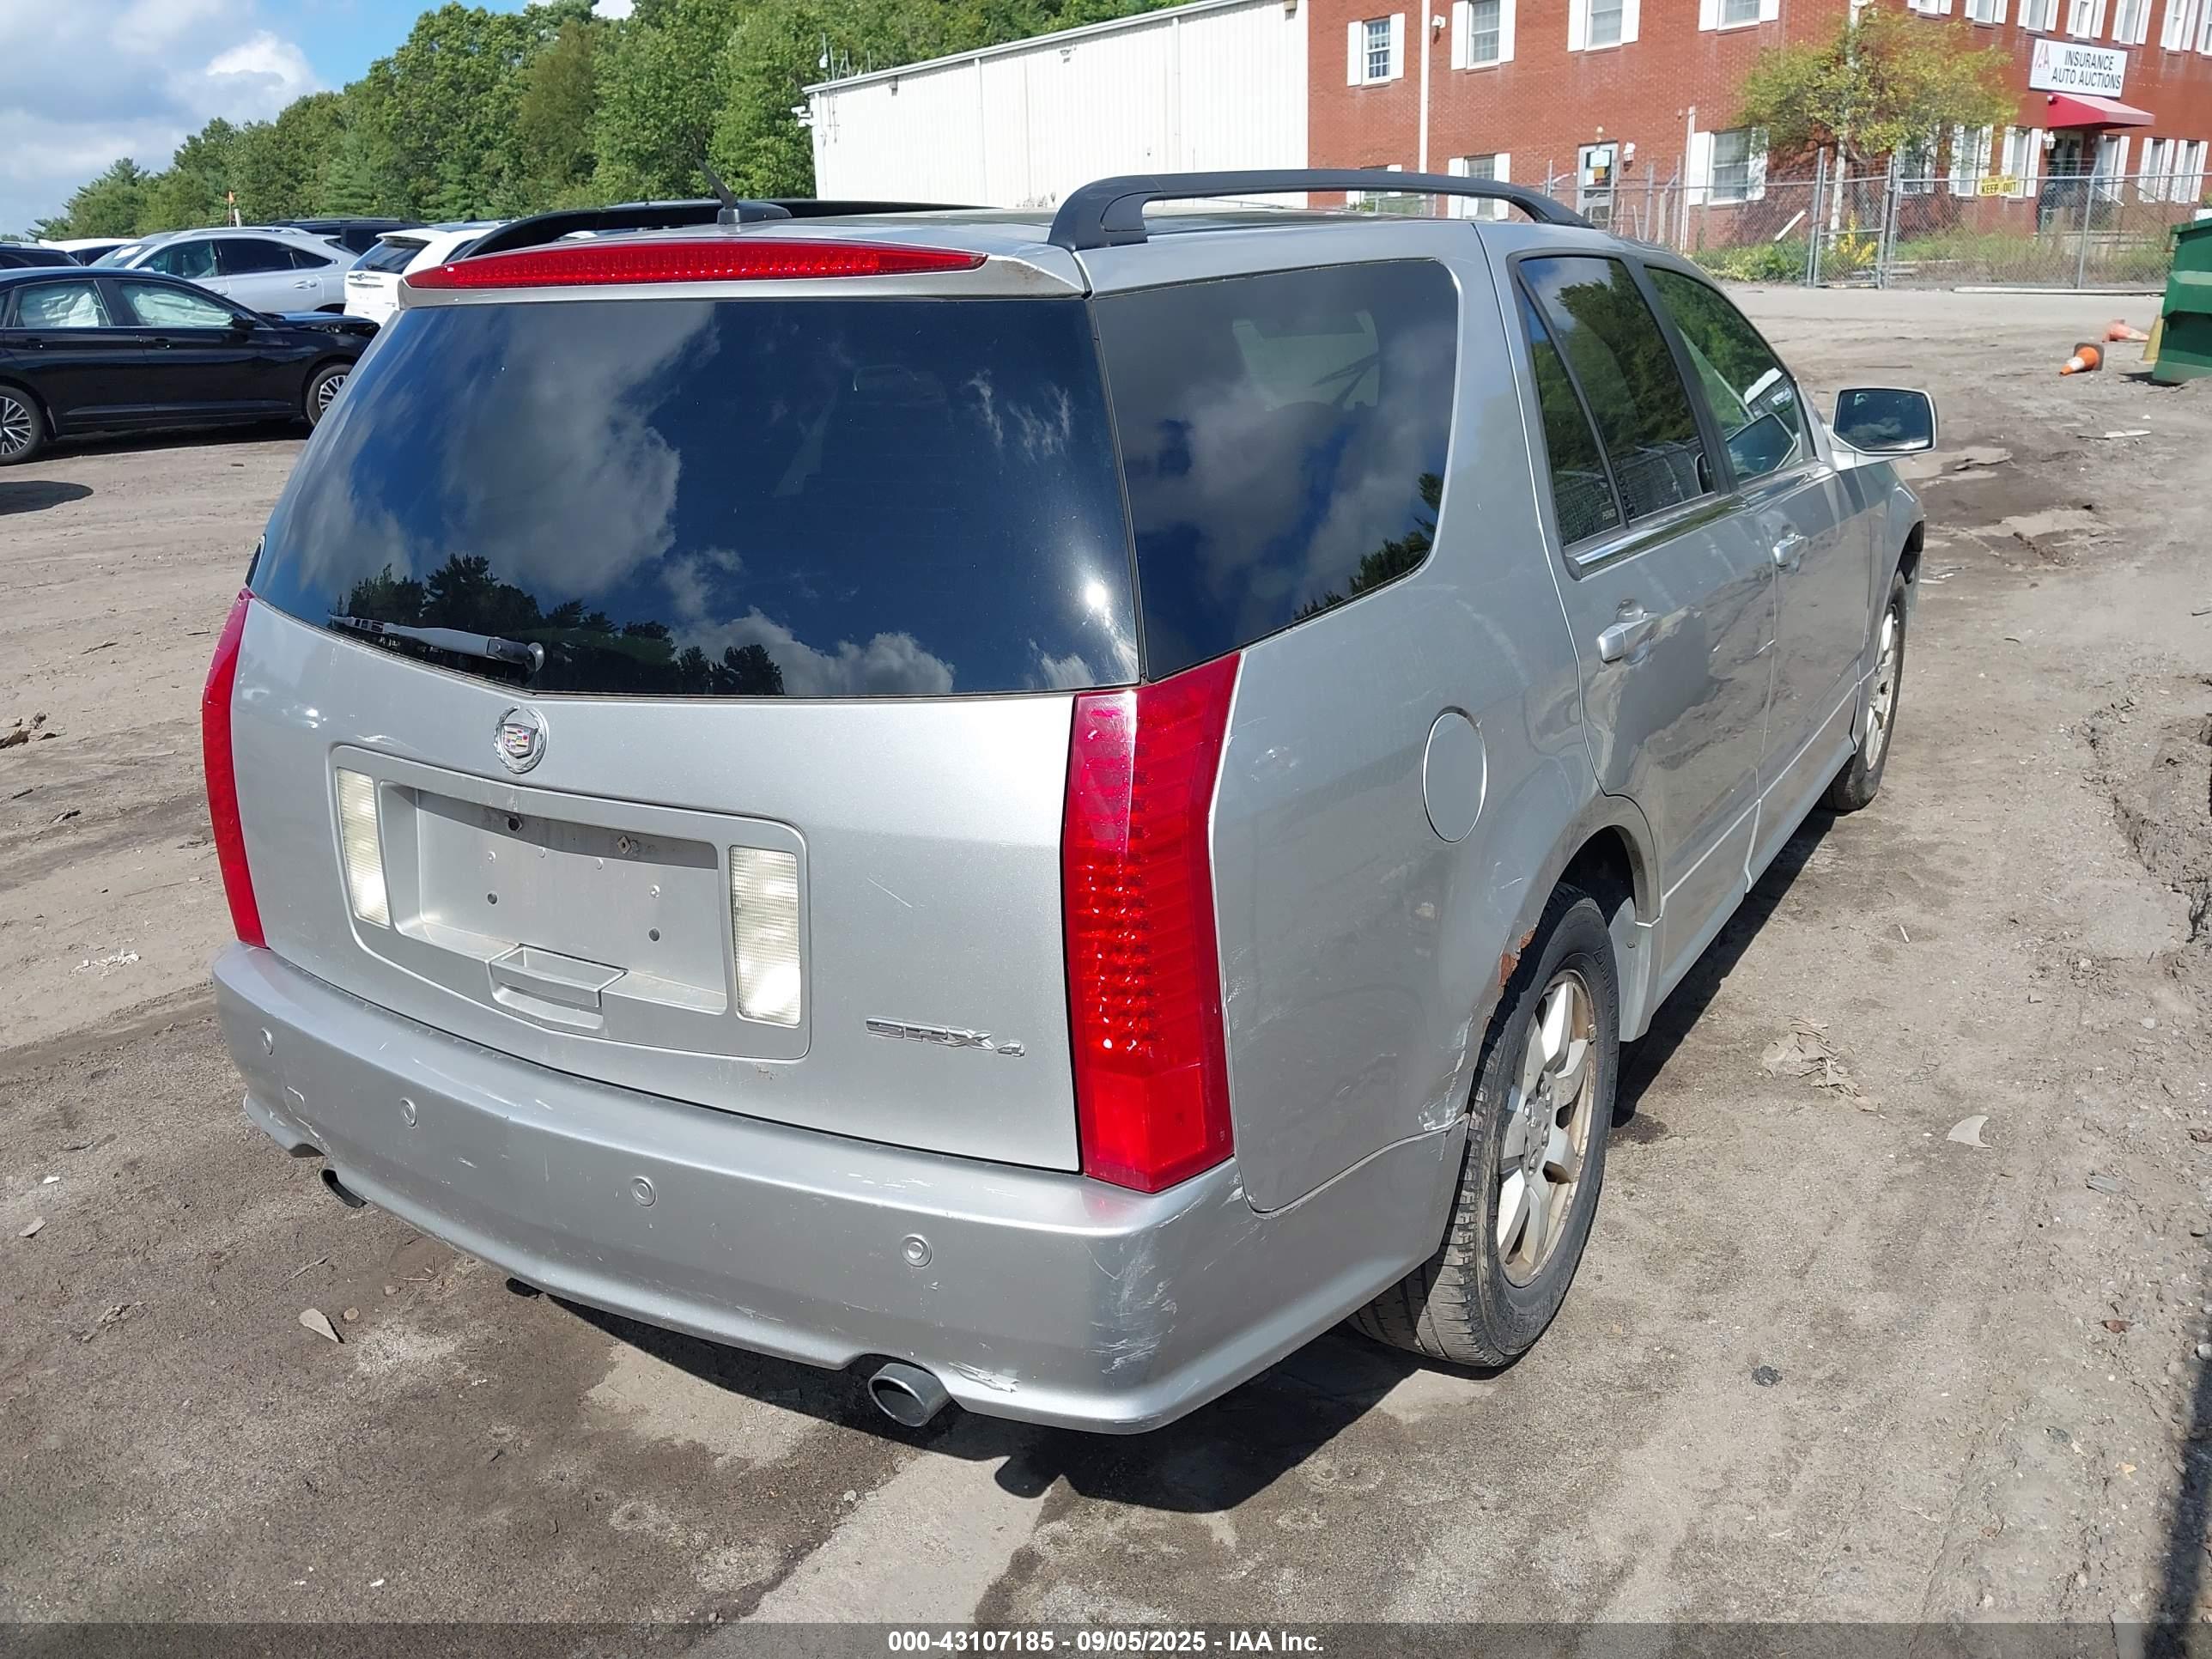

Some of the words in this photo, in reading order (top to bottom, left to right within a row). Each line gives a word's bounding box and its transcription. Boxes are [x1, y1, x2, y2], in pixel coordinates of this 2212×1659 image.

[2064, 50, 2115, 70] INSURANCE
[2051, 67, 2076, 84] AUTO
[2078, 70, 2122, 89] AUCTIONS
[1981, 183, 1999, 194] KEEP
[2003, 181, 2016, 193] OUT
